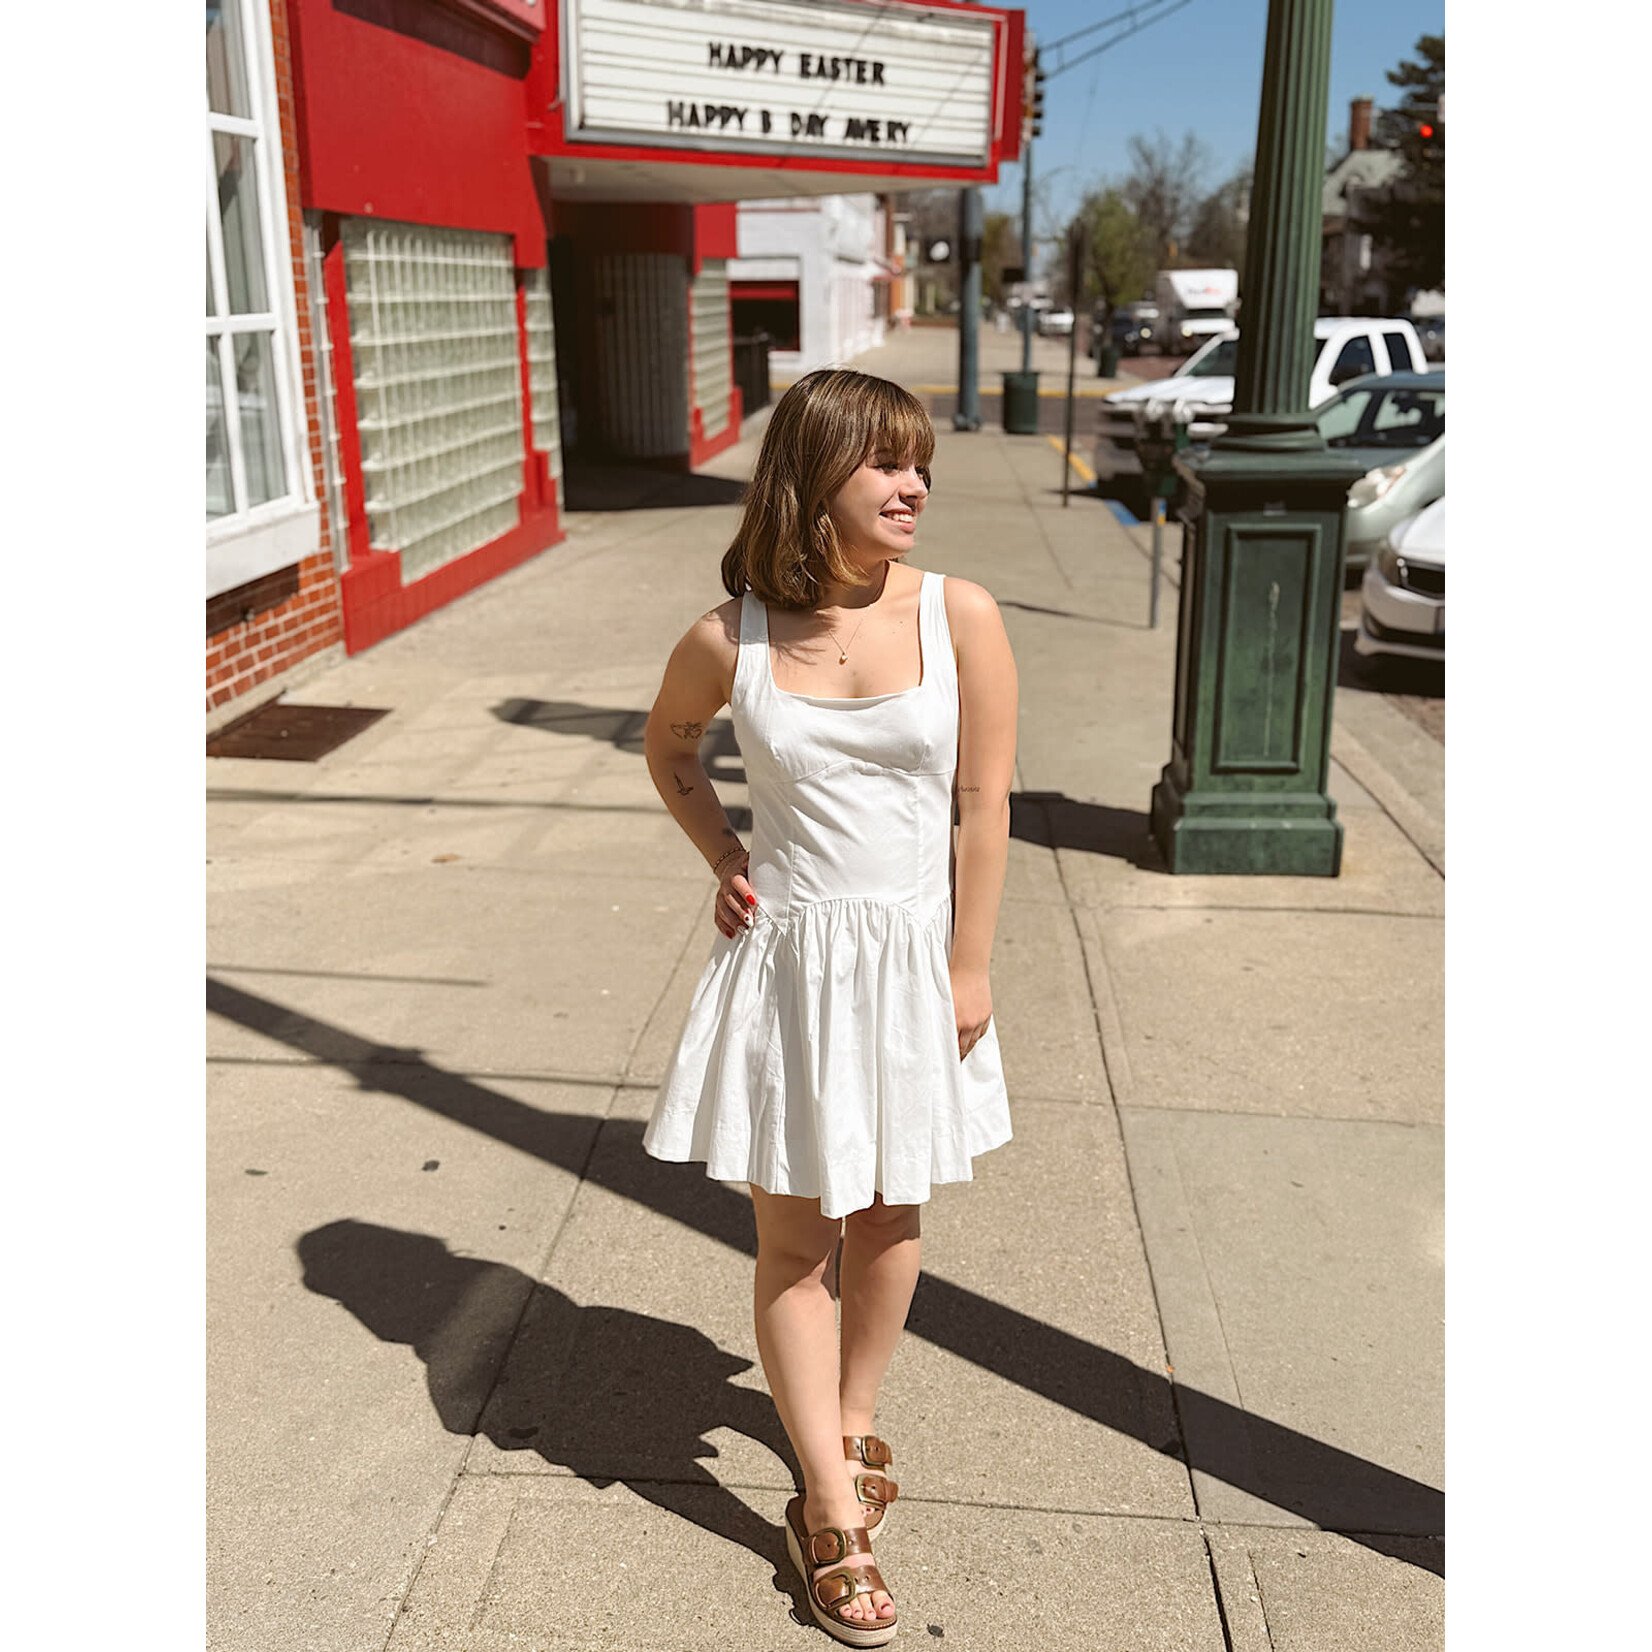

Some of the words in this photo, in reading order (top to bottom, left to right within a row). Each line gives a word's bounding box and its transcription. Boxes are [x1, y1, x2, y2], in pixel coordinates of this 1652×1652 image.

[709, 41, 783, 74] HAPPY
[800, 54, 885, 85] EASTER
[668, 100, 747, 130] HAPPY
[760, 109, 772, 134] B
[790, 112, 828, 137] DAY
[844, 117, 910, 142] AVERY
